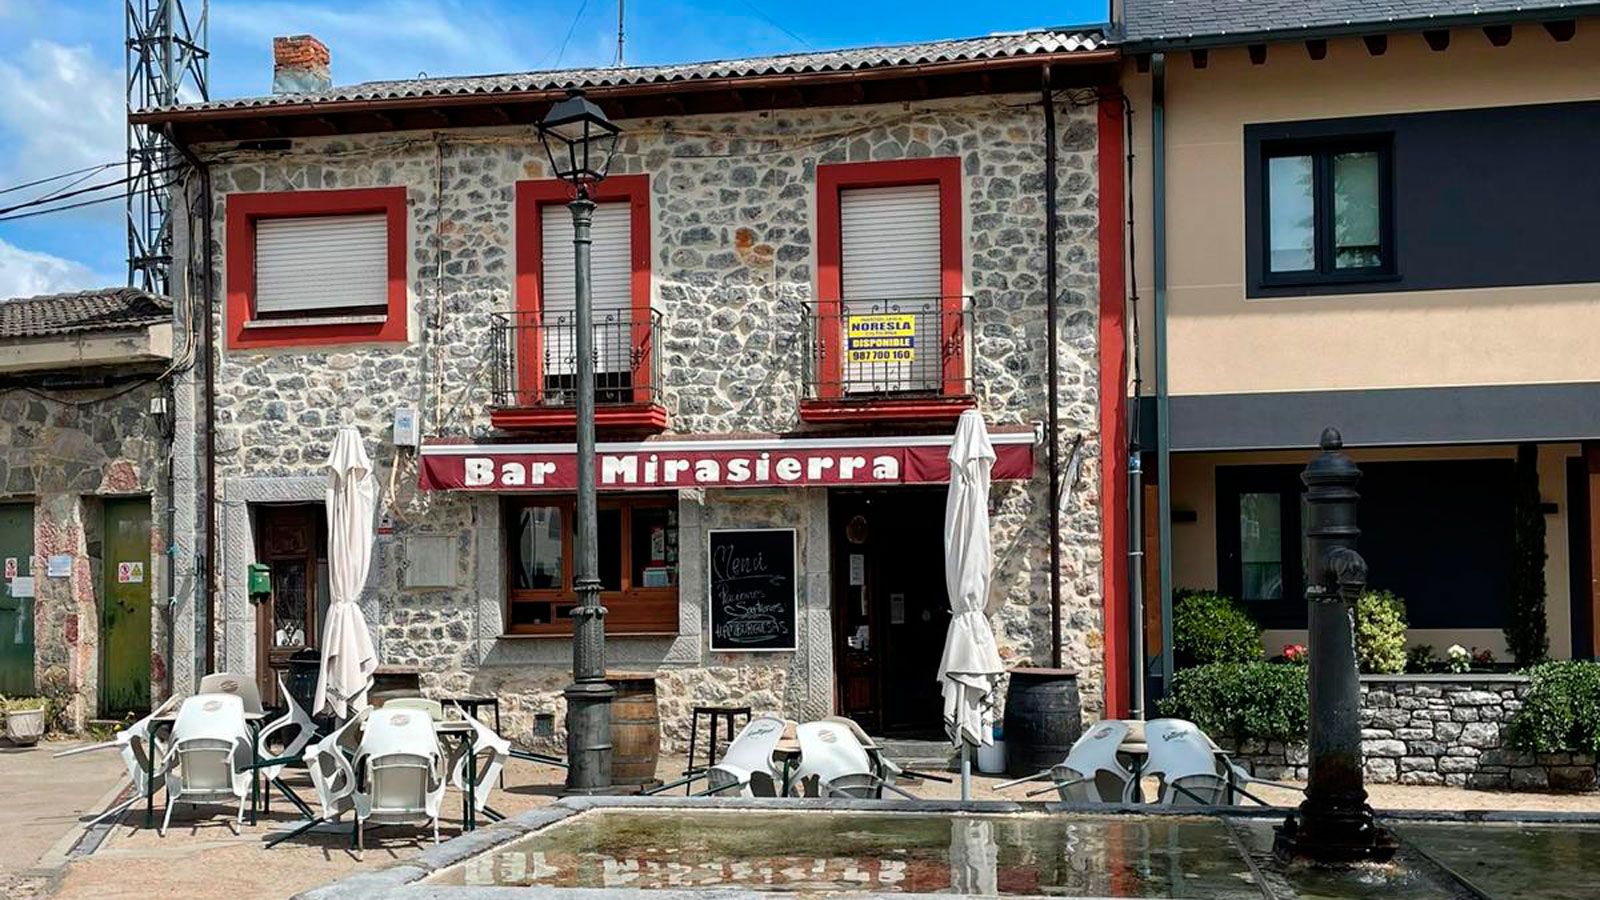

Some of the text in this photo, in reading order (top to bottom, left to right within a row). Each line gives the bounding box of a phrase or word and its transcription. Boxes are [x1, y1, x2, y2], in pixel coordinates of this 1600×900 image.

[851, 322, 912, 331] NORESLA
[852, 338, 911, 348] DISPONIBLE
[853, 350, 911, 361] 987 700 160
[464, 450, 899, 486] Bar Mirasierra
